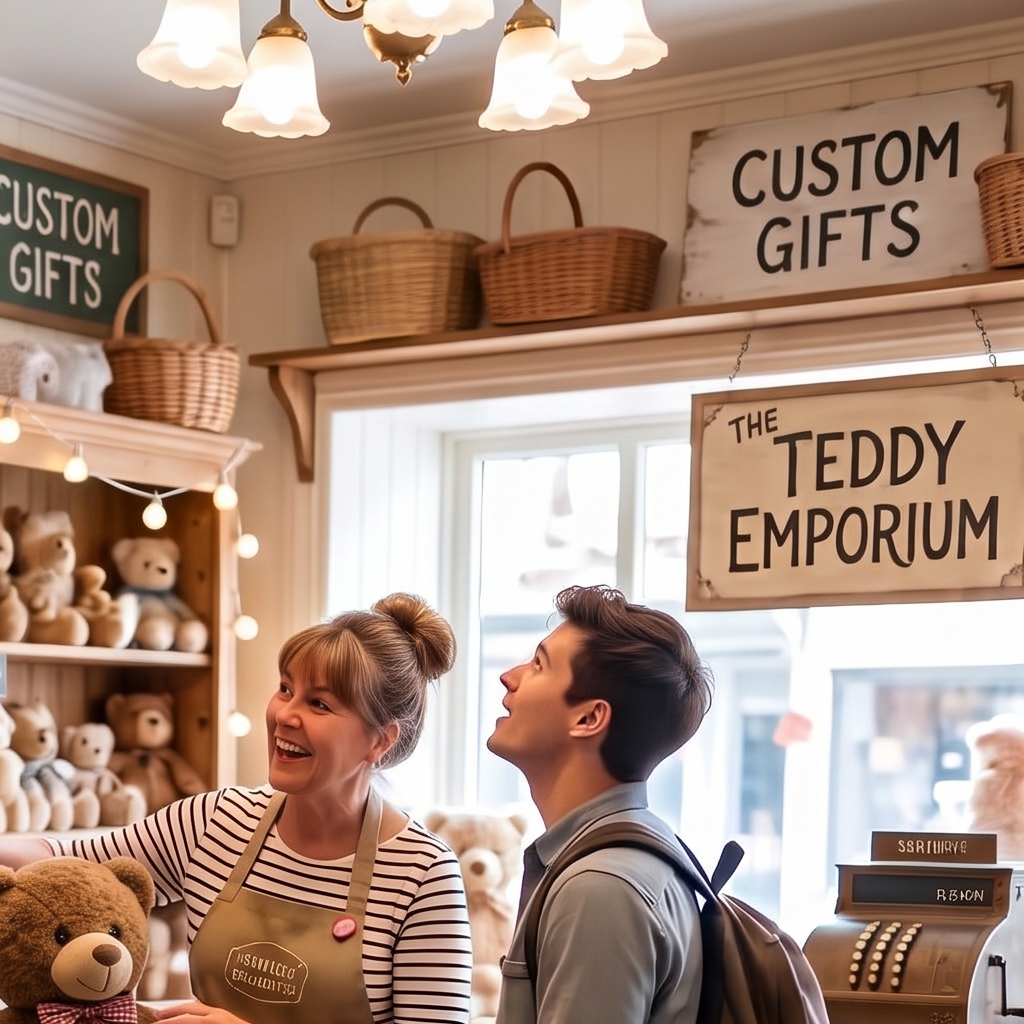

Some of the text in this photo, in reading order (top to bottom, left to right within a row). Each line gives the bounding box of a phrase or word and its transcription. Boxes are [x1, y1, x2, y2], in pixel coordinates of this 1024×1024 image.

[732, 120, 960, 208] CUSTOM
[9, 242, 102, 309] GIFTS
[756, 199, 921, 275] GIFTS
[727, 407, 779, 444] THE
[772, 419, 967, 498] TEDDY
[728, 495, 999, 574] EMPORIUM
